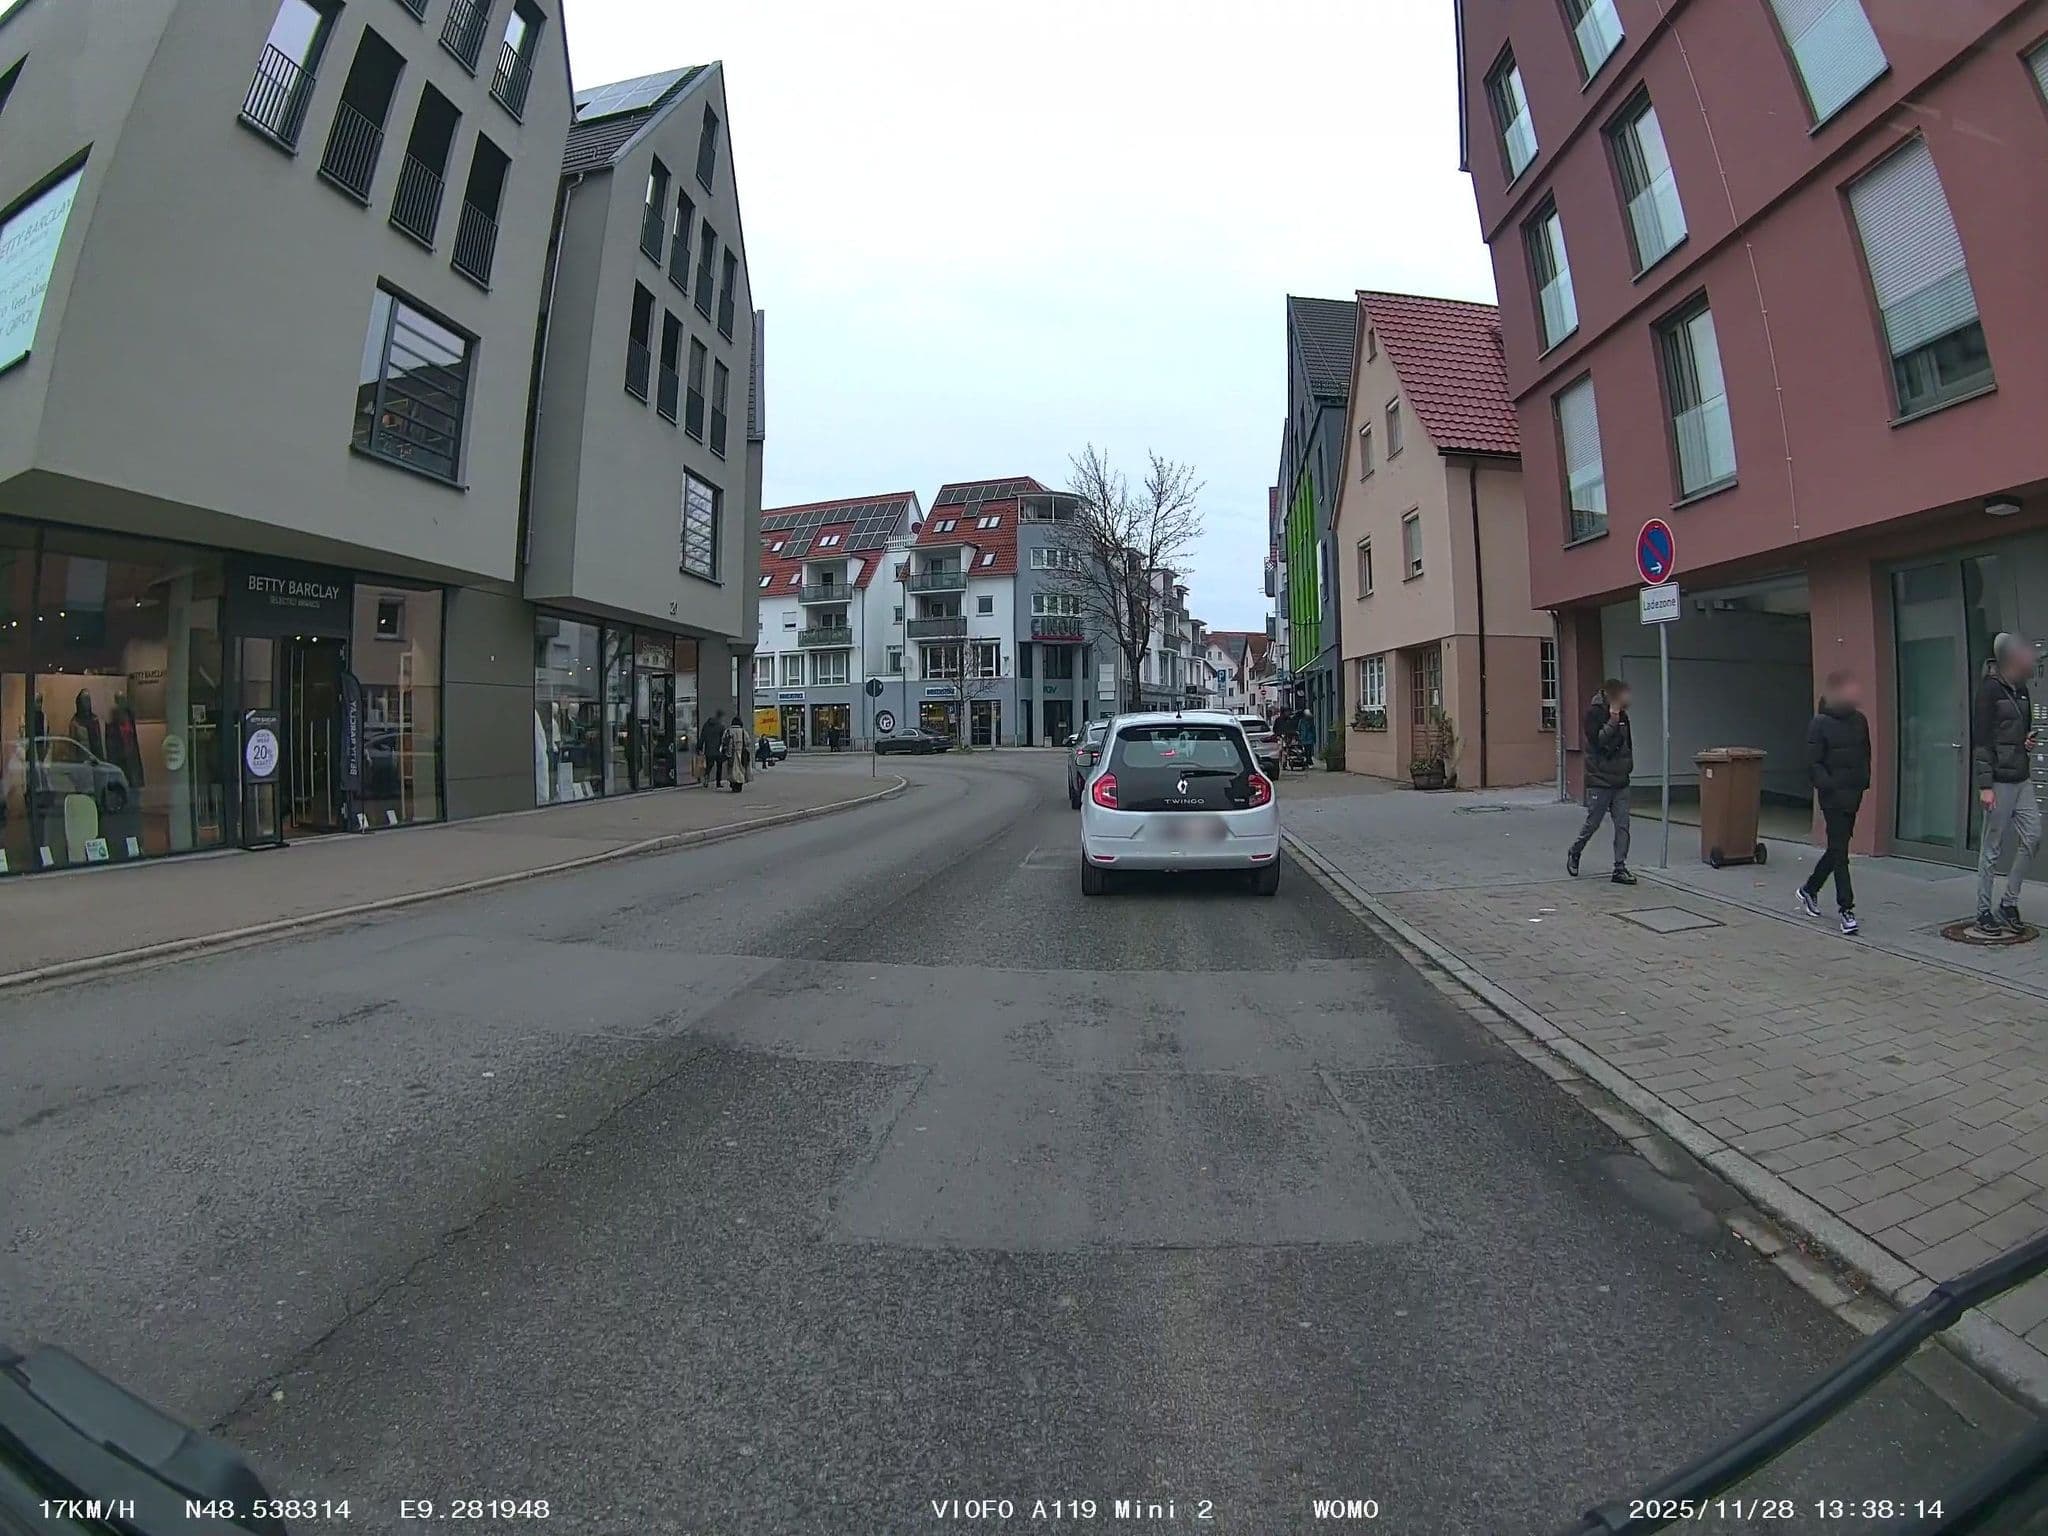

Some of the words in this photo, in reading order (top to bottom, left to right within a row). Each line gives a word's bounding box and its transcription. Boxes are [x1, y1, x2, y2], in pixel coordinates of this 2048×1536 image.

[248, 575, 285, 592] BETTY
[288, 580, 339, 599] BARCLAY
[1643, 598, 1676, 611] Ladezone
